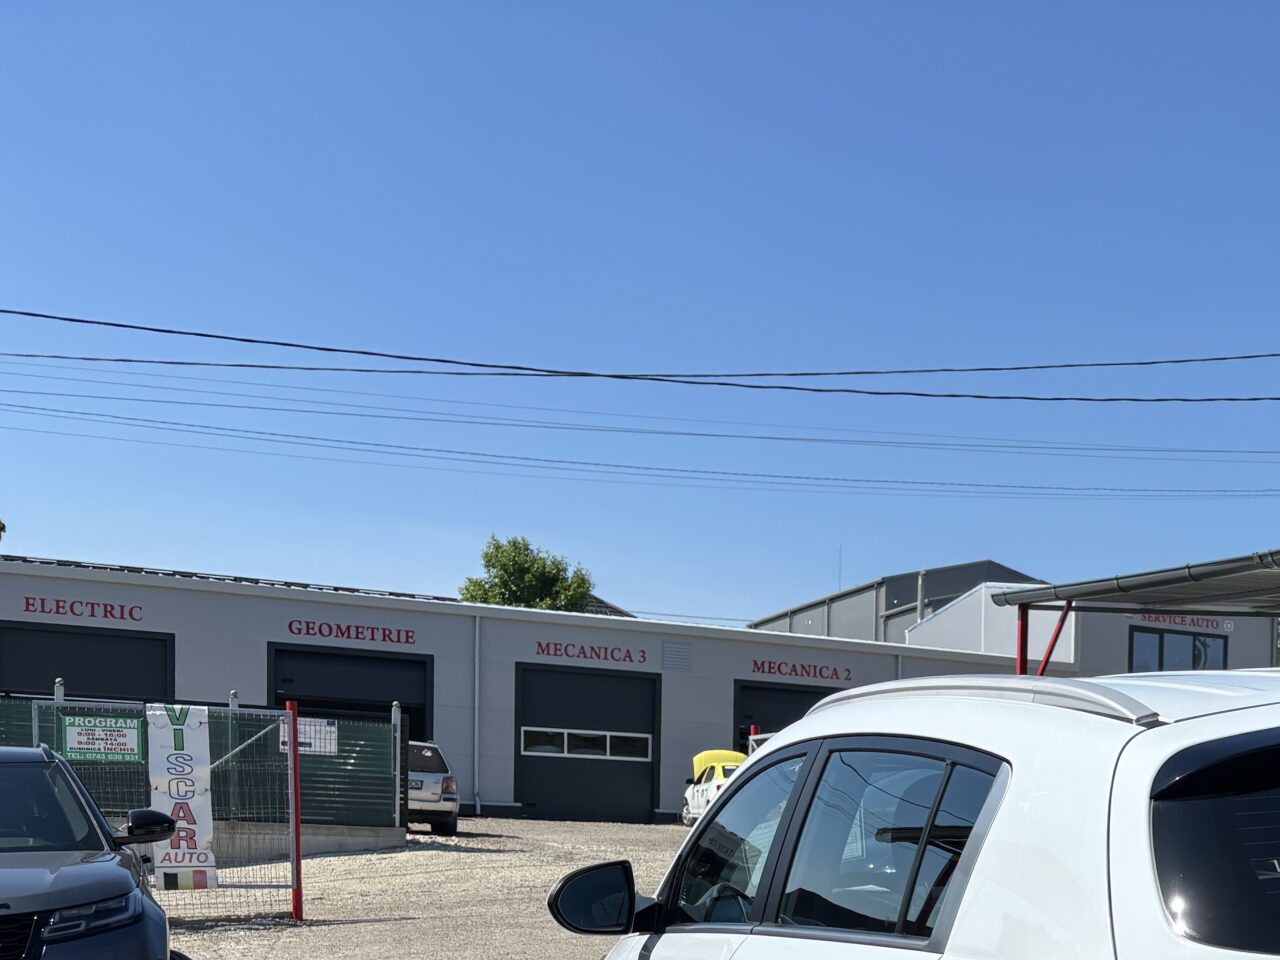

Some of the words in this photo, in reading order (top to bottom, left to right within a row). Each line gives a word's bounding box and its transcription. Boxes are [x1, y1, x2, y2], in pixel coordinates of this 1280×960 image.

[23, 596, 144, 622] ELECTRIC
[287, 619, 417, 645] GEOMETRIE
[1141, 614, 1187, 625] SERVICE
[1189, 618, 1220, 629] AUTO
[535, 640, 634, 663] MECANICA
[638, 649, 647, 664] 3
[751, 659, 840, 681] MECANICA
[844, 668, 853, 681] 2
[65, 717, 138, 728] PROGRAM
[164, 705, 198, 850] VISCAR
[160, 851, 209, 864] AUTO
